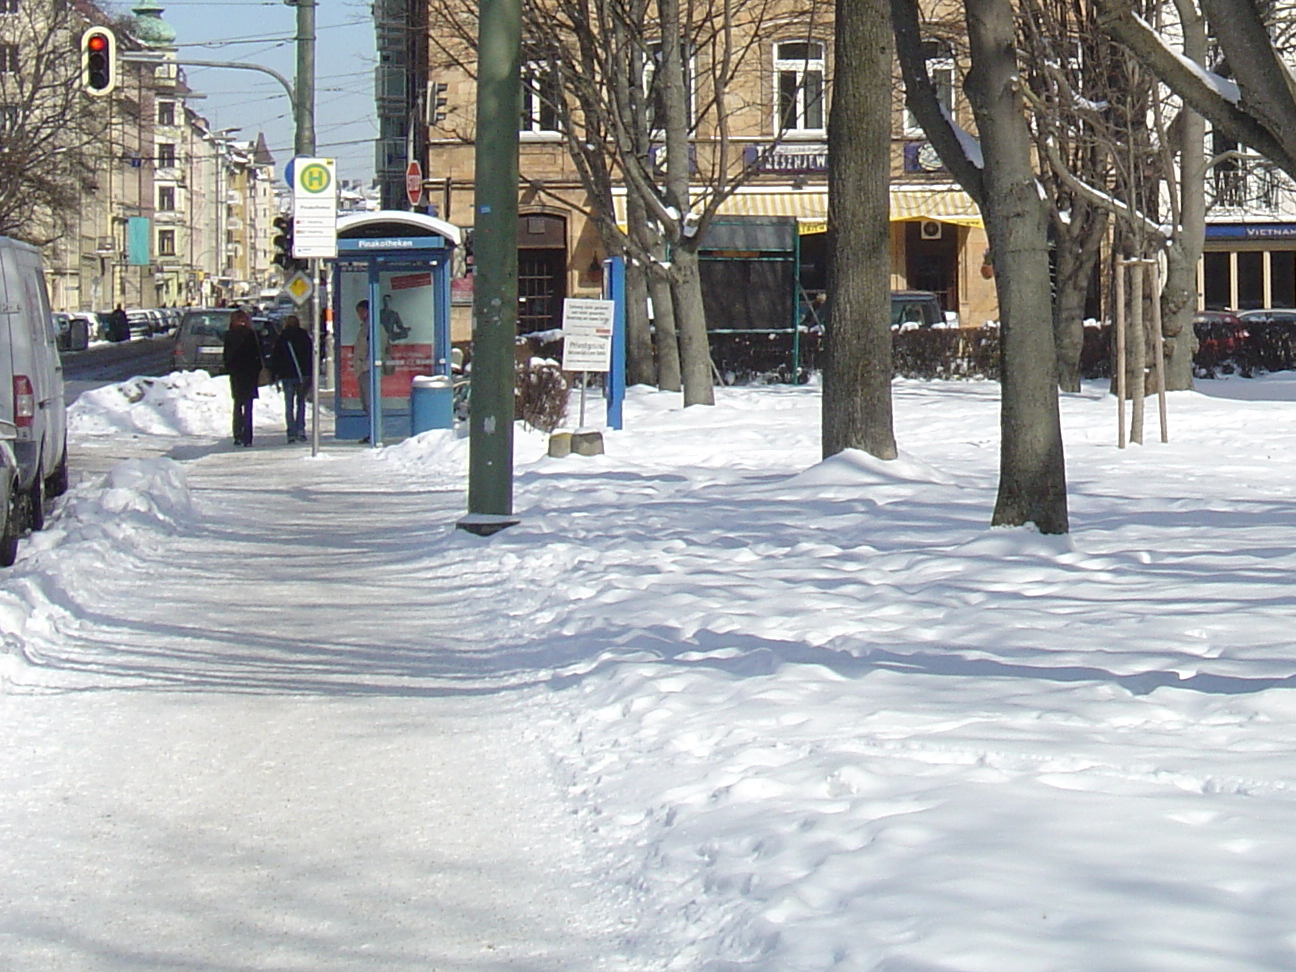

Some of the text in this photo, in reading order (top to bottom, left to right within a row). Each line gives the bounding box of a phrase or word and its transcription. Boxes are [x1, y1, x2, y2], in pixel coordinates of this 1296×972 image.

[308, 171, 323, 186] H
[407, 174, 420, 192] STOP
[358, 239, 413, 248] Pinakotheken
